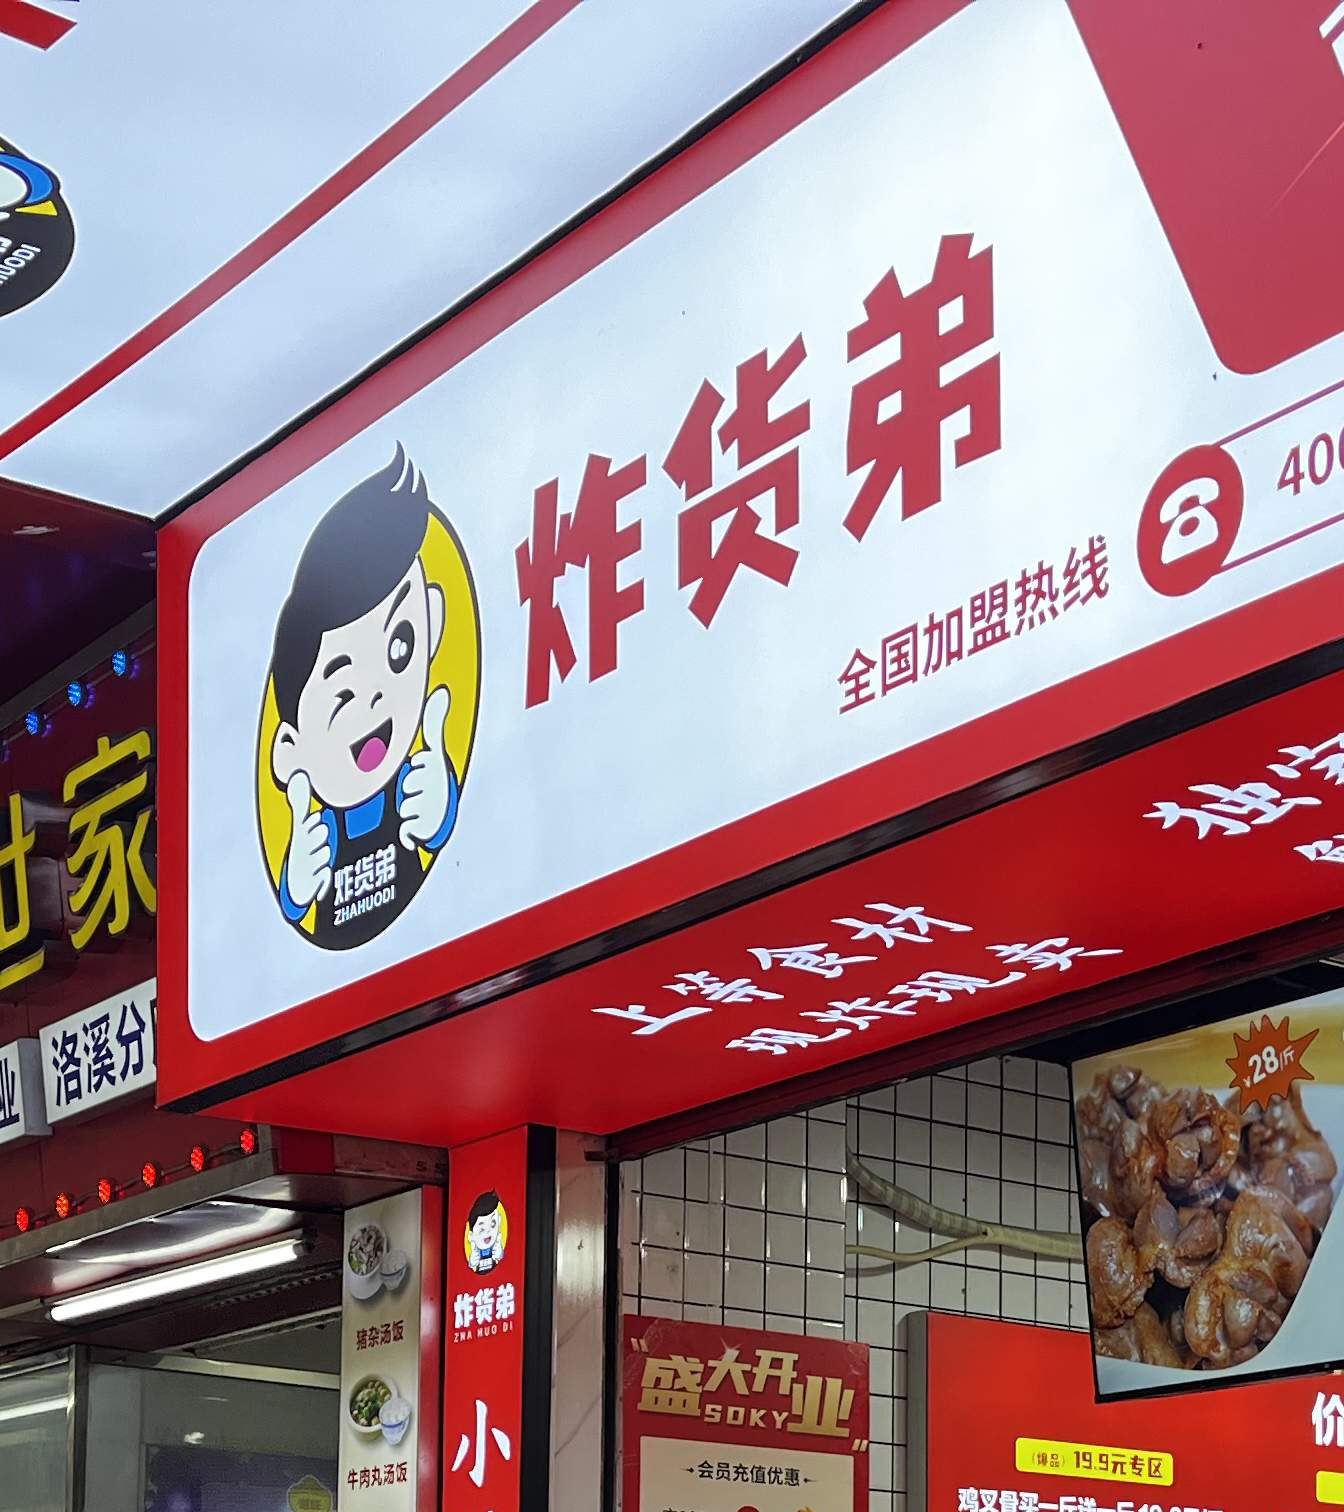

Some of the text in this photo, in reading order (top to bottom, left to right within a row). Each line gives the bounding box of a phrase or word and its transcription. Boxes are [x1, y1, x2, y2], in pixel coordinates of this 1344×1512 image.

[515, 233, 1001, 709] 炸货弟
[837, 535, 1109, 714] 全国加盟热线
[334, 843, 396, 906] 炸货弟
[334, 885, 395, 926] ZHAHUODI
[591, 902, 972, 1035] 上等食材
[725, 937, 1123, 1055] 现炸现卖
[52, 997, 157, 1107] 洛溪分
[453, 1282, 515, 1329] 炸货弟
[356, 1319, 404, 1351] 猪杂汤饭
[453, 1330, 472, 1343] ZHA
[503, 1320, 514, 1333] DI
[637, 1347, 855, 1438] 盛大开业
[704, 1403, 790, 1430] SOKY
[348, 1461, 408, 1490] 牛肉丸汤饭
[697, 1459, 801, 1488] 会员充值优惠
[1073, 1450, 1163, 1479] 19.9元专区
